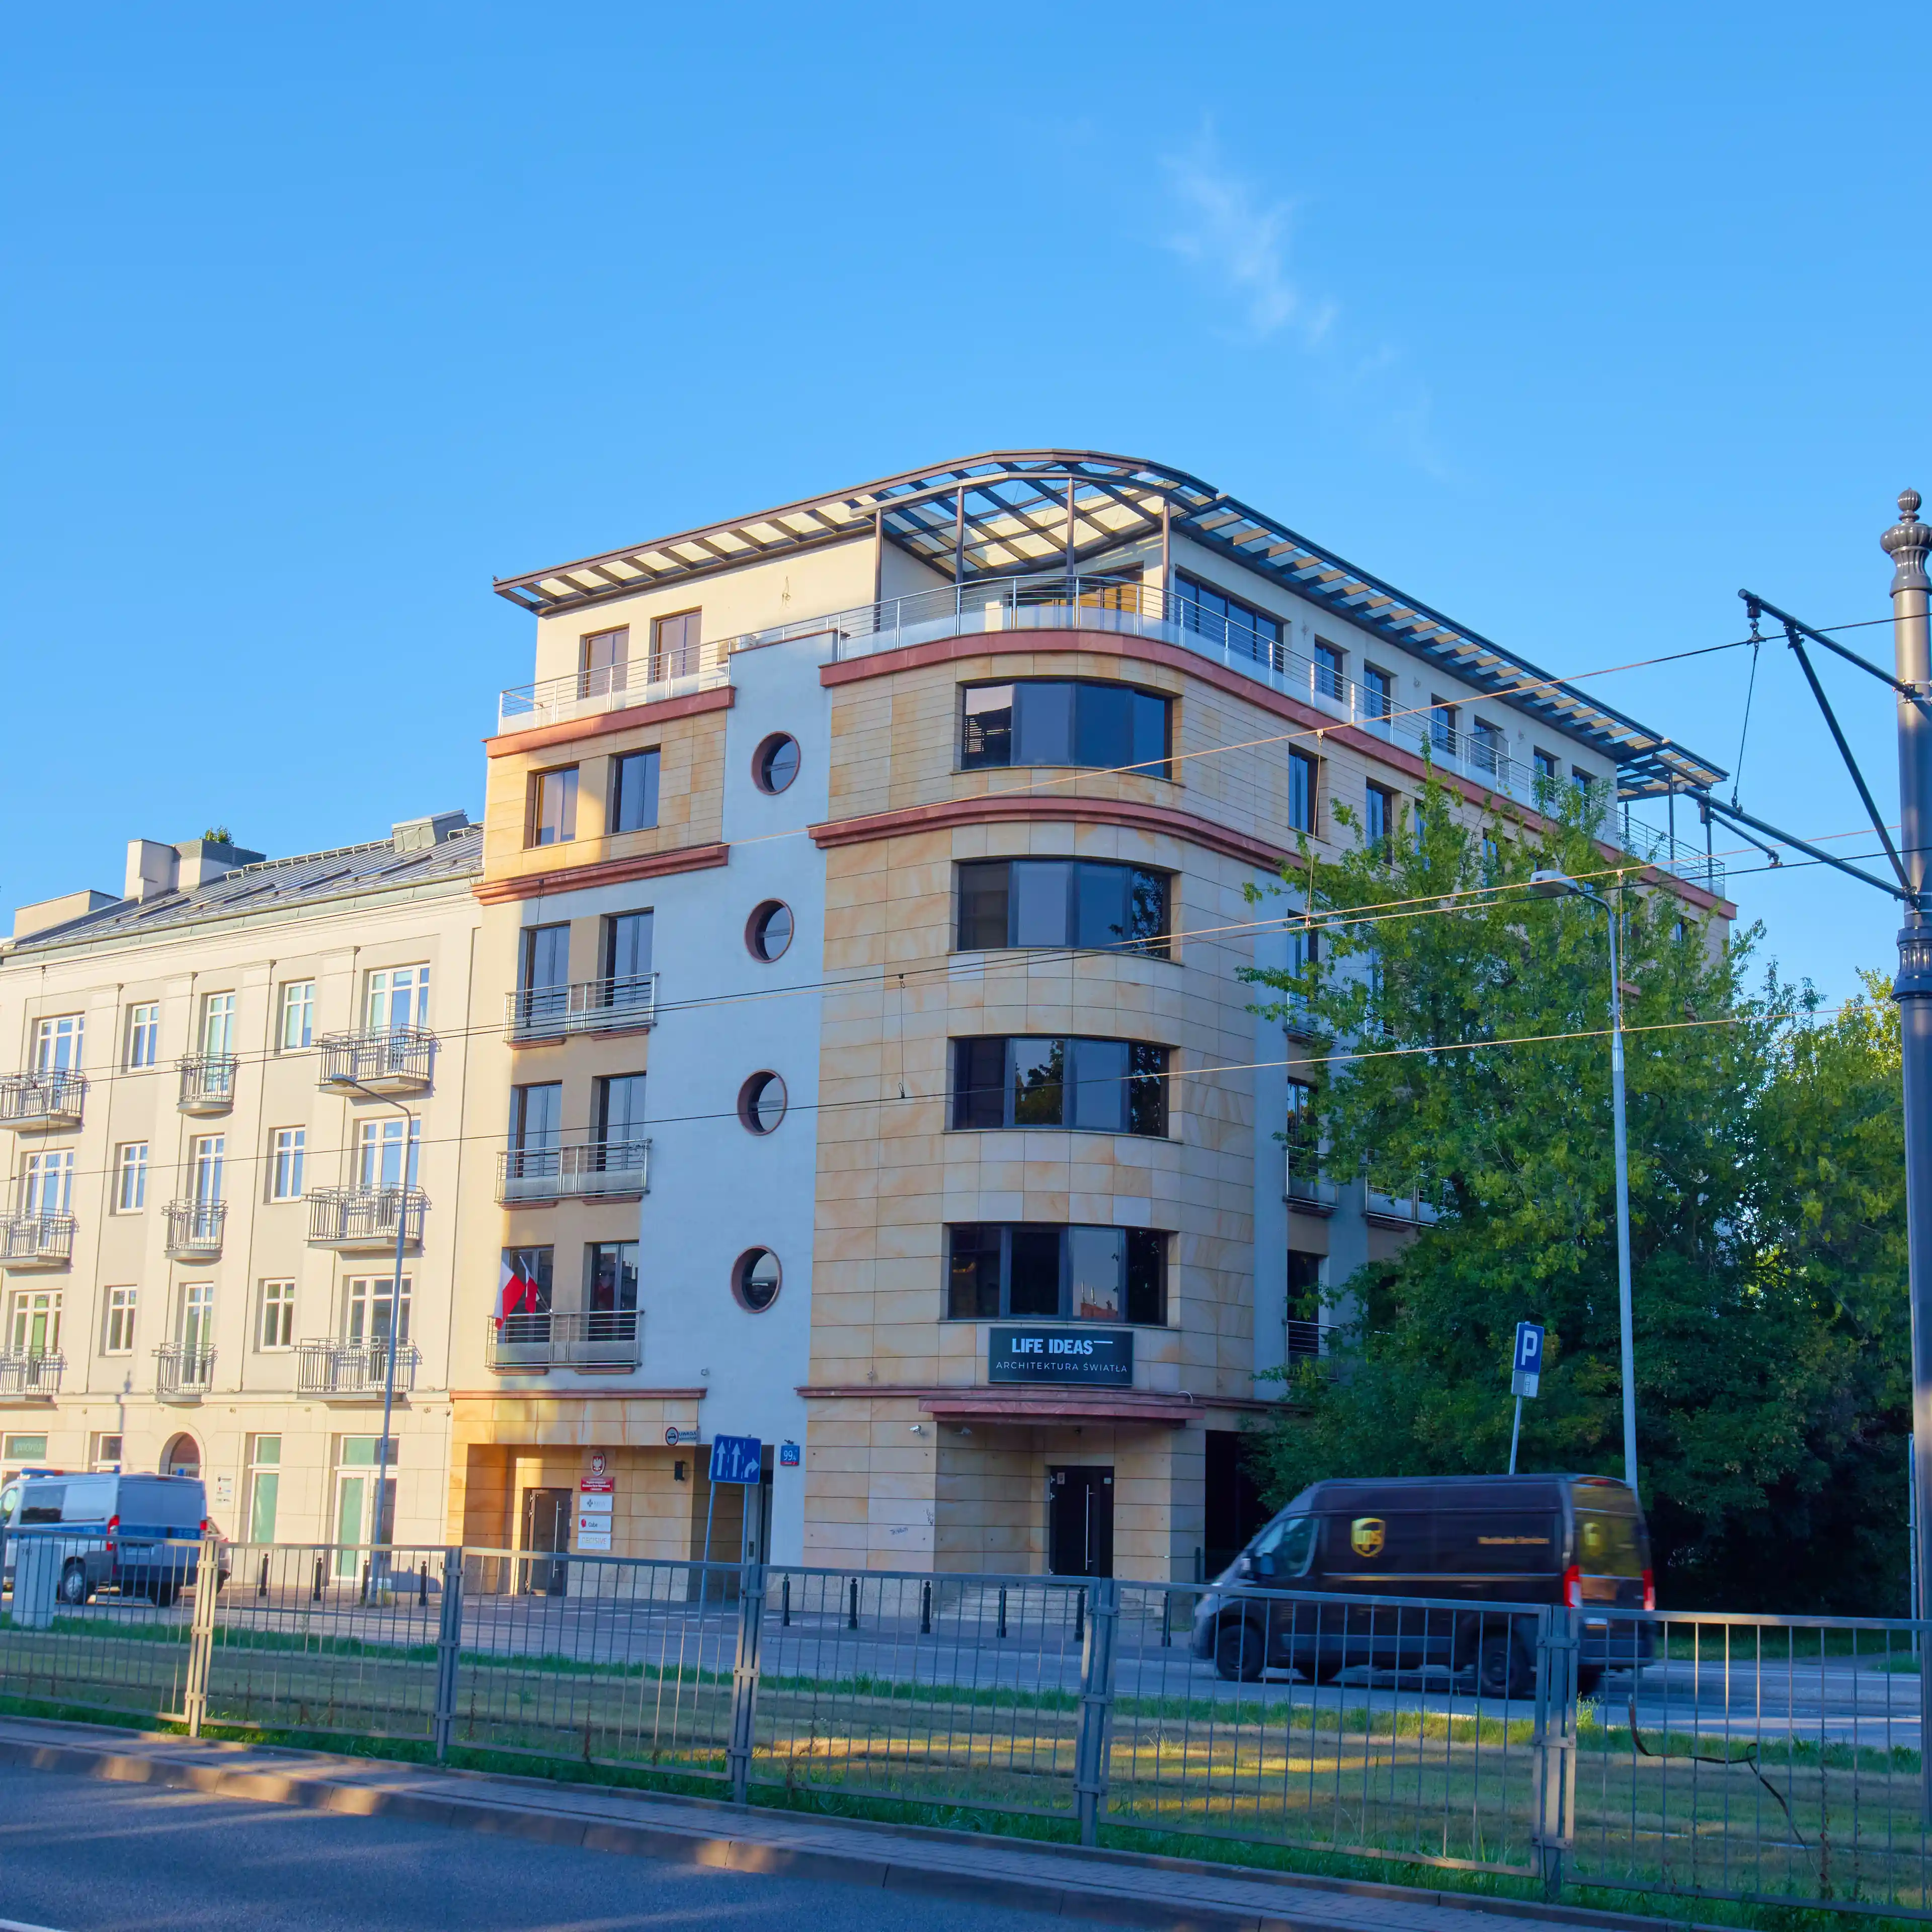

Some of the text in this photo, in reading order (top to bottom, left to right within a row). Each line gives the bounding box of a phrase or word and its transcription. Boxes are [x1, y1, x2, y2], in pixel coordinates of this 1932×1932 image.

[1012, 1338, 1093, 1355] LIFE IDEAS
[1521, 1330, 1538, 1365] P
[996, 1361, 1128, 1373] ARCHITEKTURA ŚWIATŁA
